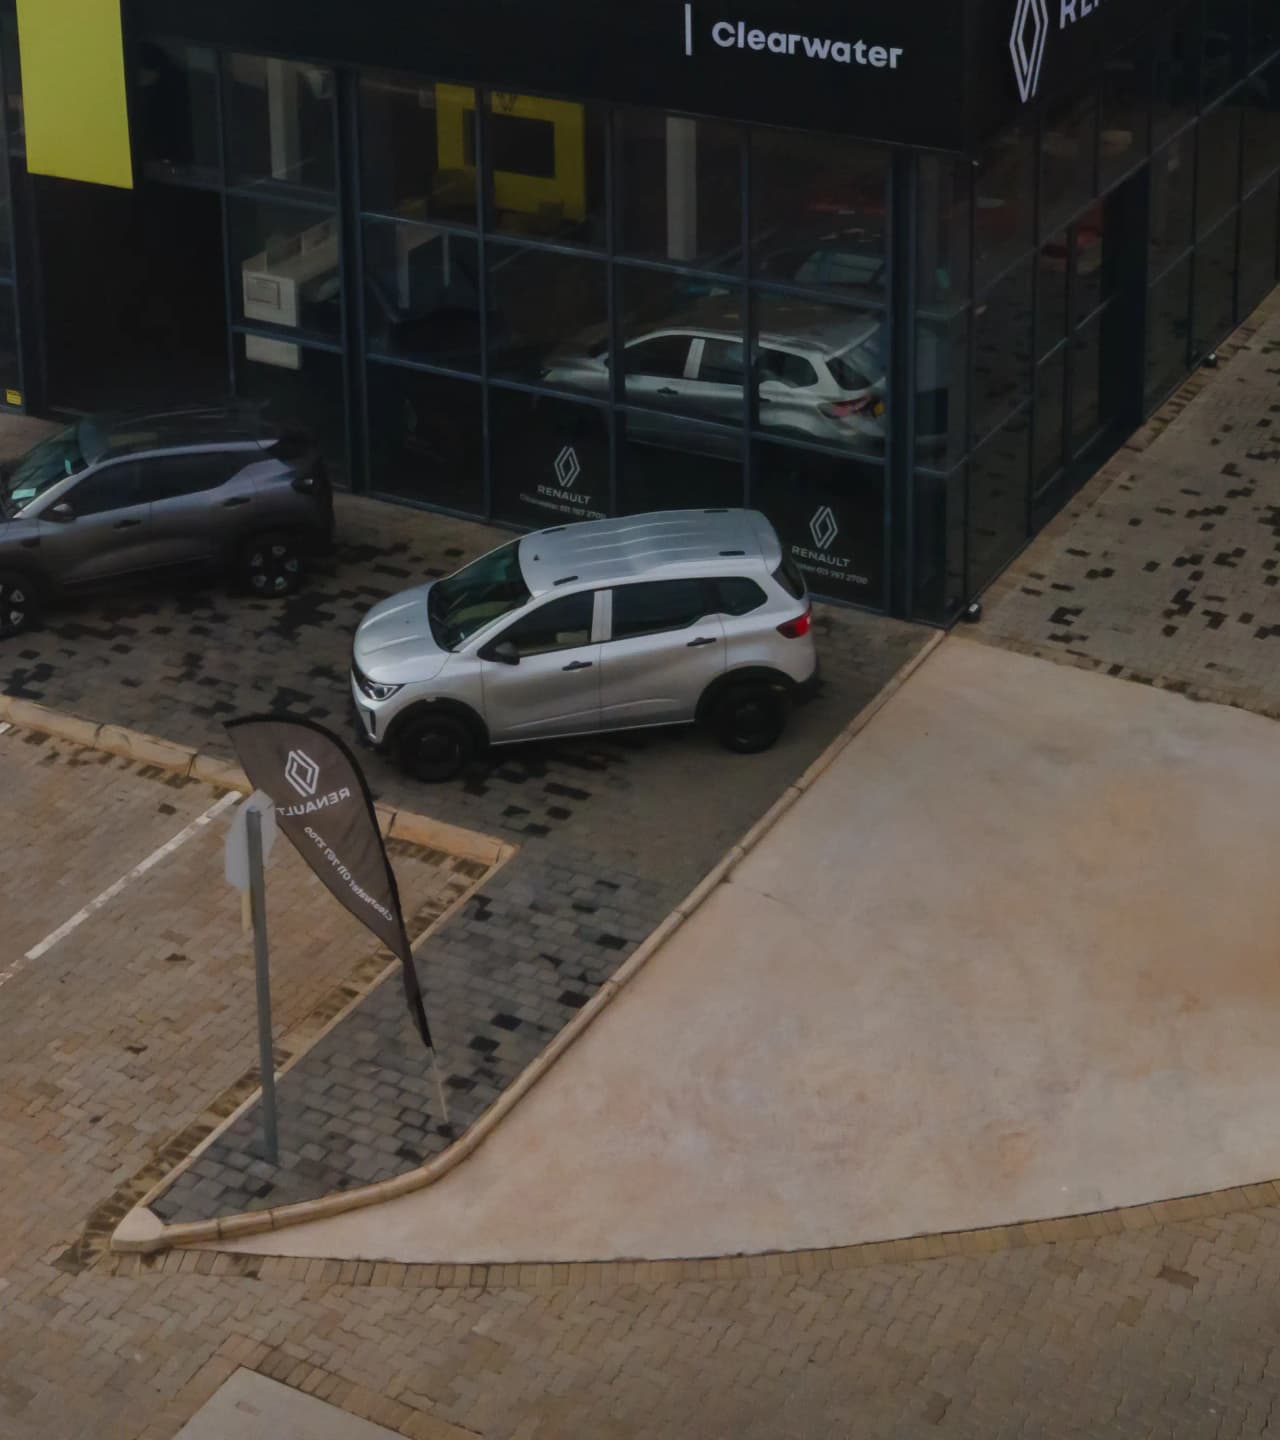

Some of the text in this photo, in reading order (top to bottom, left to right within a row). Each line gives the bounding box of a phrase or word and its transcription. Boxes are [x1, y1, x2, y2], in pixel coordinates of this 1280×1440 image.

[711, 21, 904, 69] Clearwater
[537, 485, 592, 504] RENAULT
[791, 545, 851, 567] RENAULT
